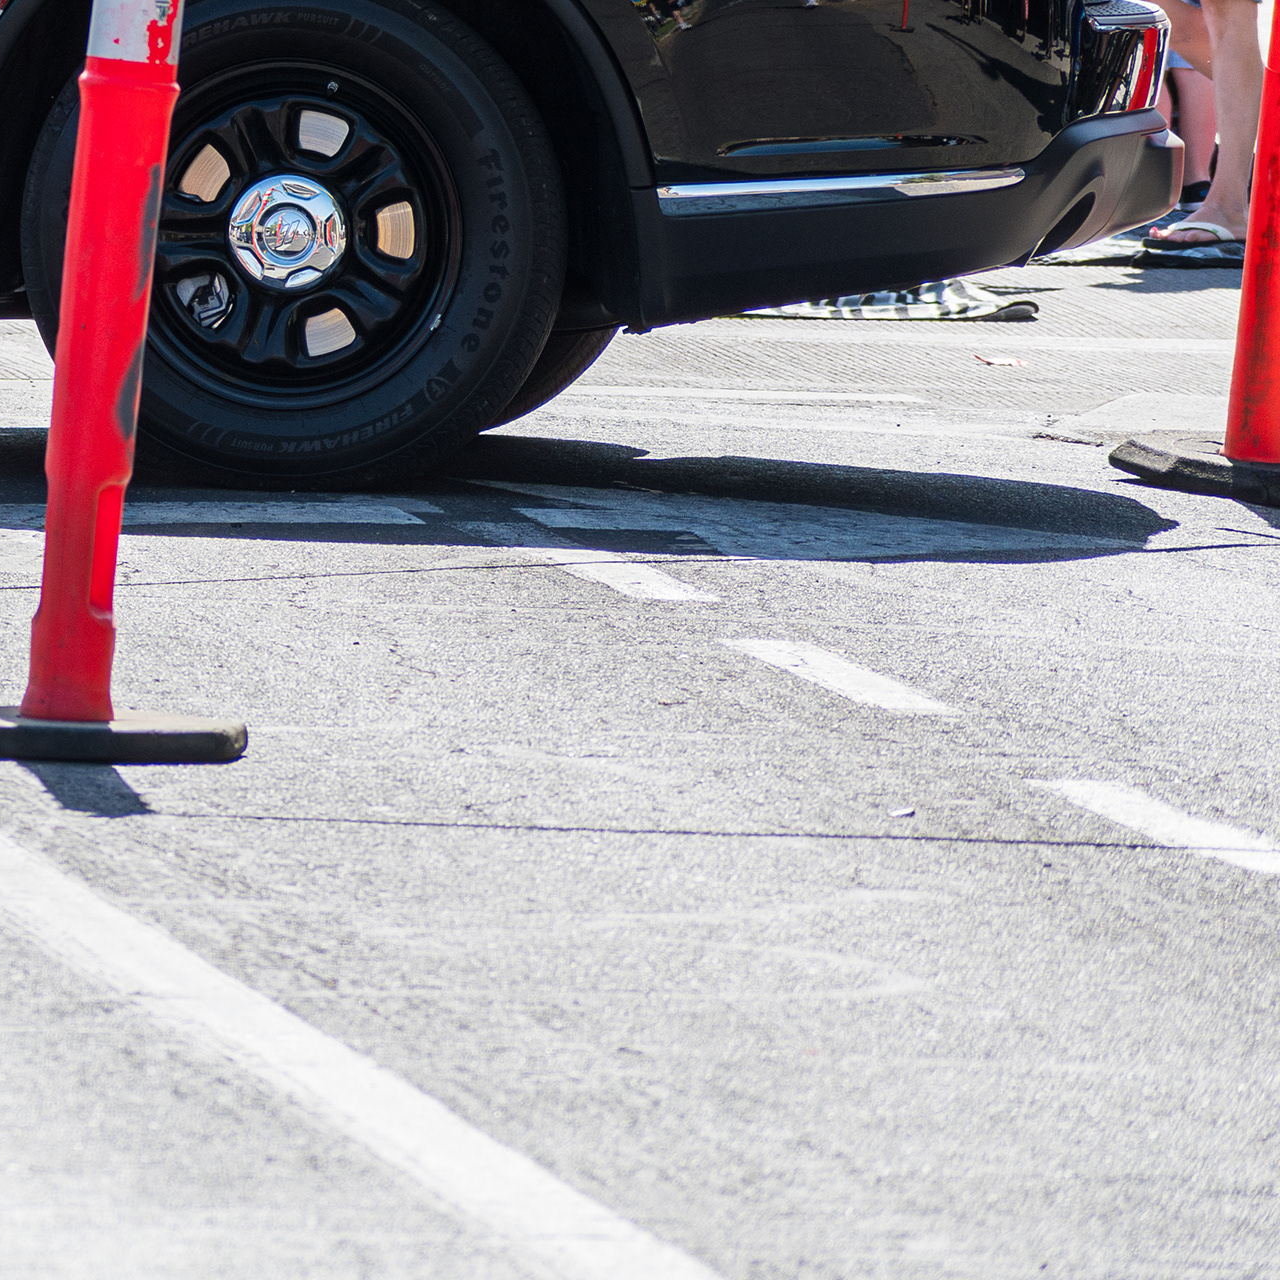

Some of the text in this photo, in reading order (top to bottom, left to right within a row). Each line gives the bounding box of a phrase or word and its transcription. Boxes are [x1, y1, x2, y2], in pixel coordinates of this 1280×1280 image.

[181, 10, 293, 47] REHAWK
[297, 11, 340, 29] PURSUIT
[462, 148, 512, 354] Firestone
[276, 403, 416, 456] FIREHAWK
